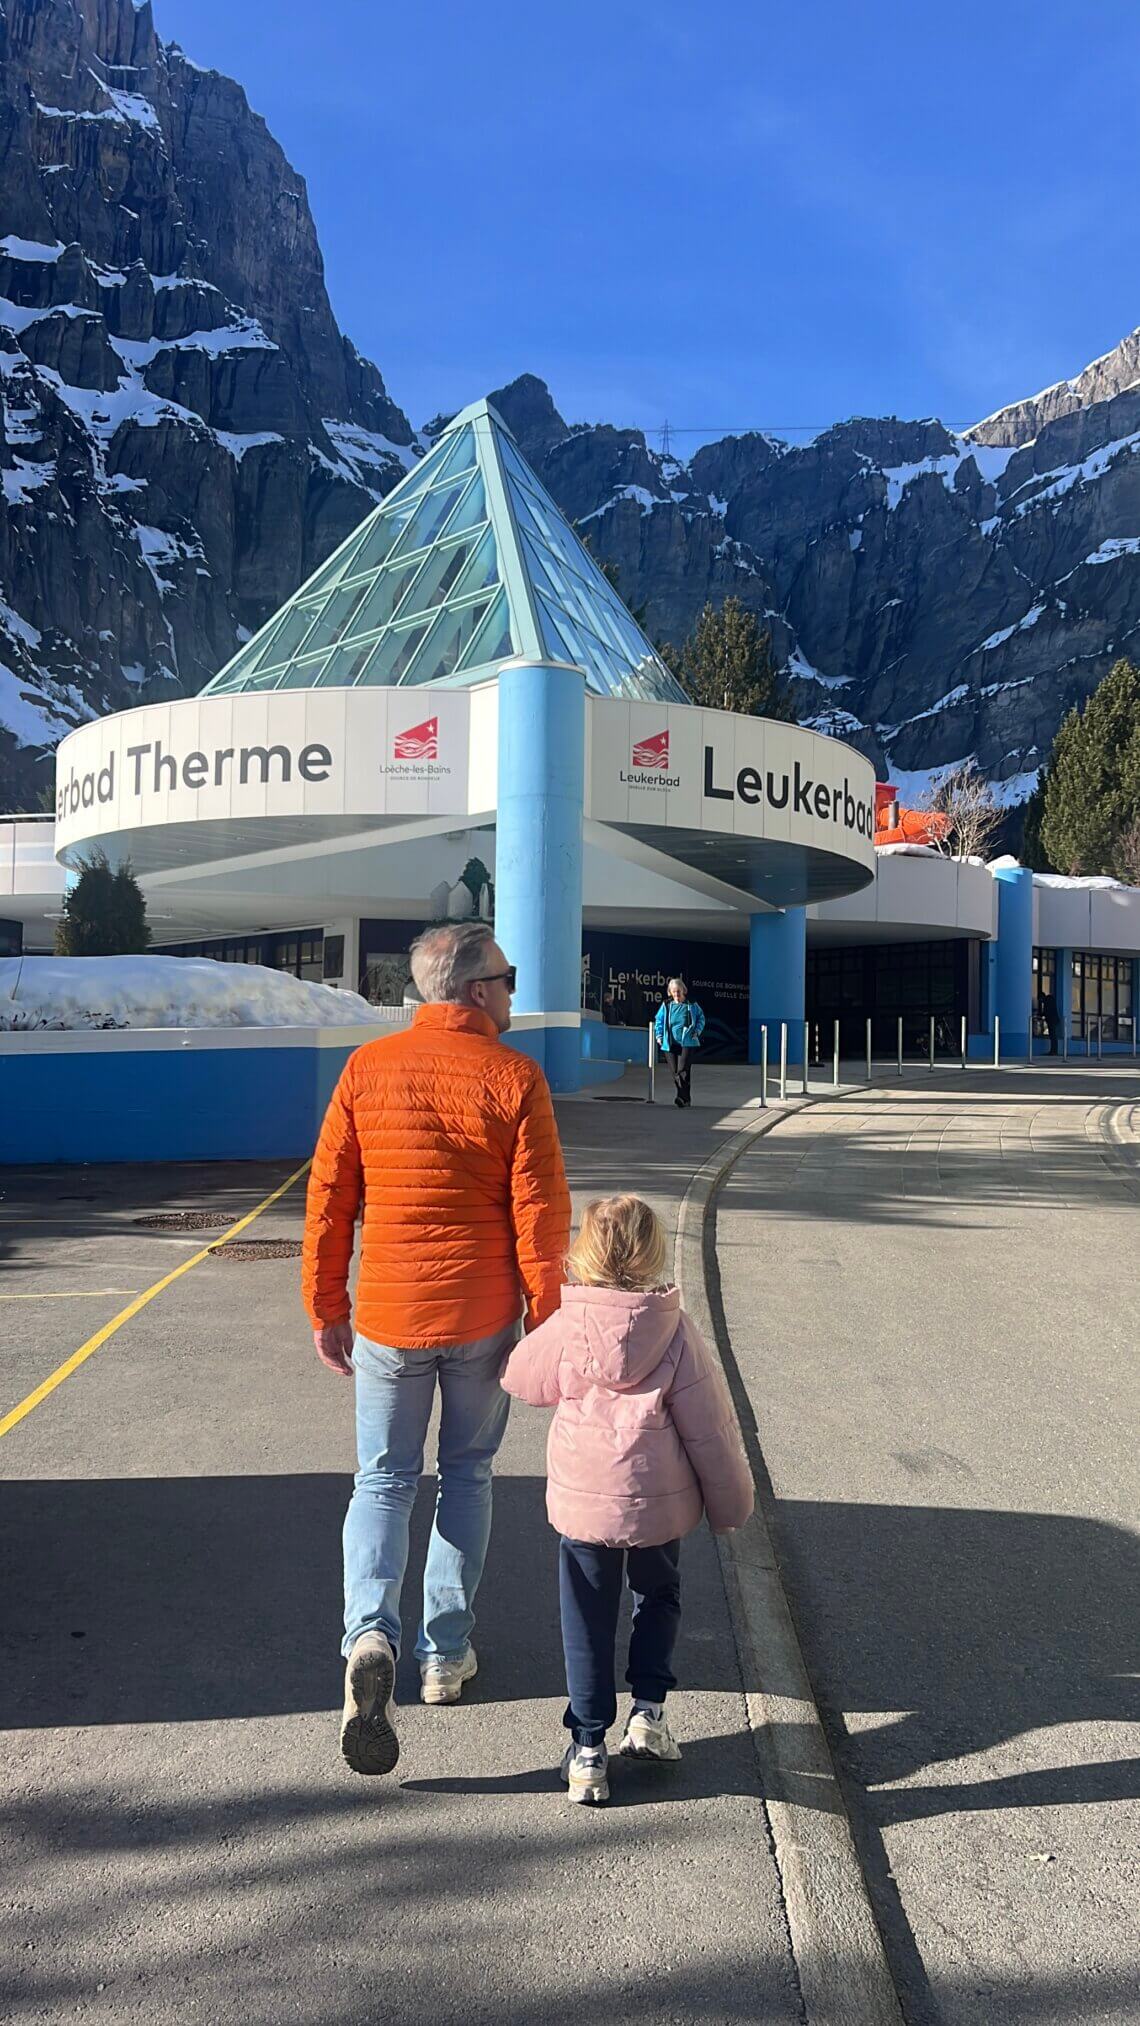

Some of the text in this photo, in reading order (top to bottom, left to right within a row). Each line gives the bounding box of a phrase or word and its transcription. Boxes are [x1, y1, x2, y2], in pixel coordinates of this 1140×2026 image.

[127, 740, 333, 796] Therme
[379, 764, 452, 774] Loèche-les-Bains
[620, 770, 681, 787] Leukerbad
[703, 746, 873, 840] Leukerbad
[609, 967, 683, 987] Lekerb
[608, 984, 663, 1003] Thme
